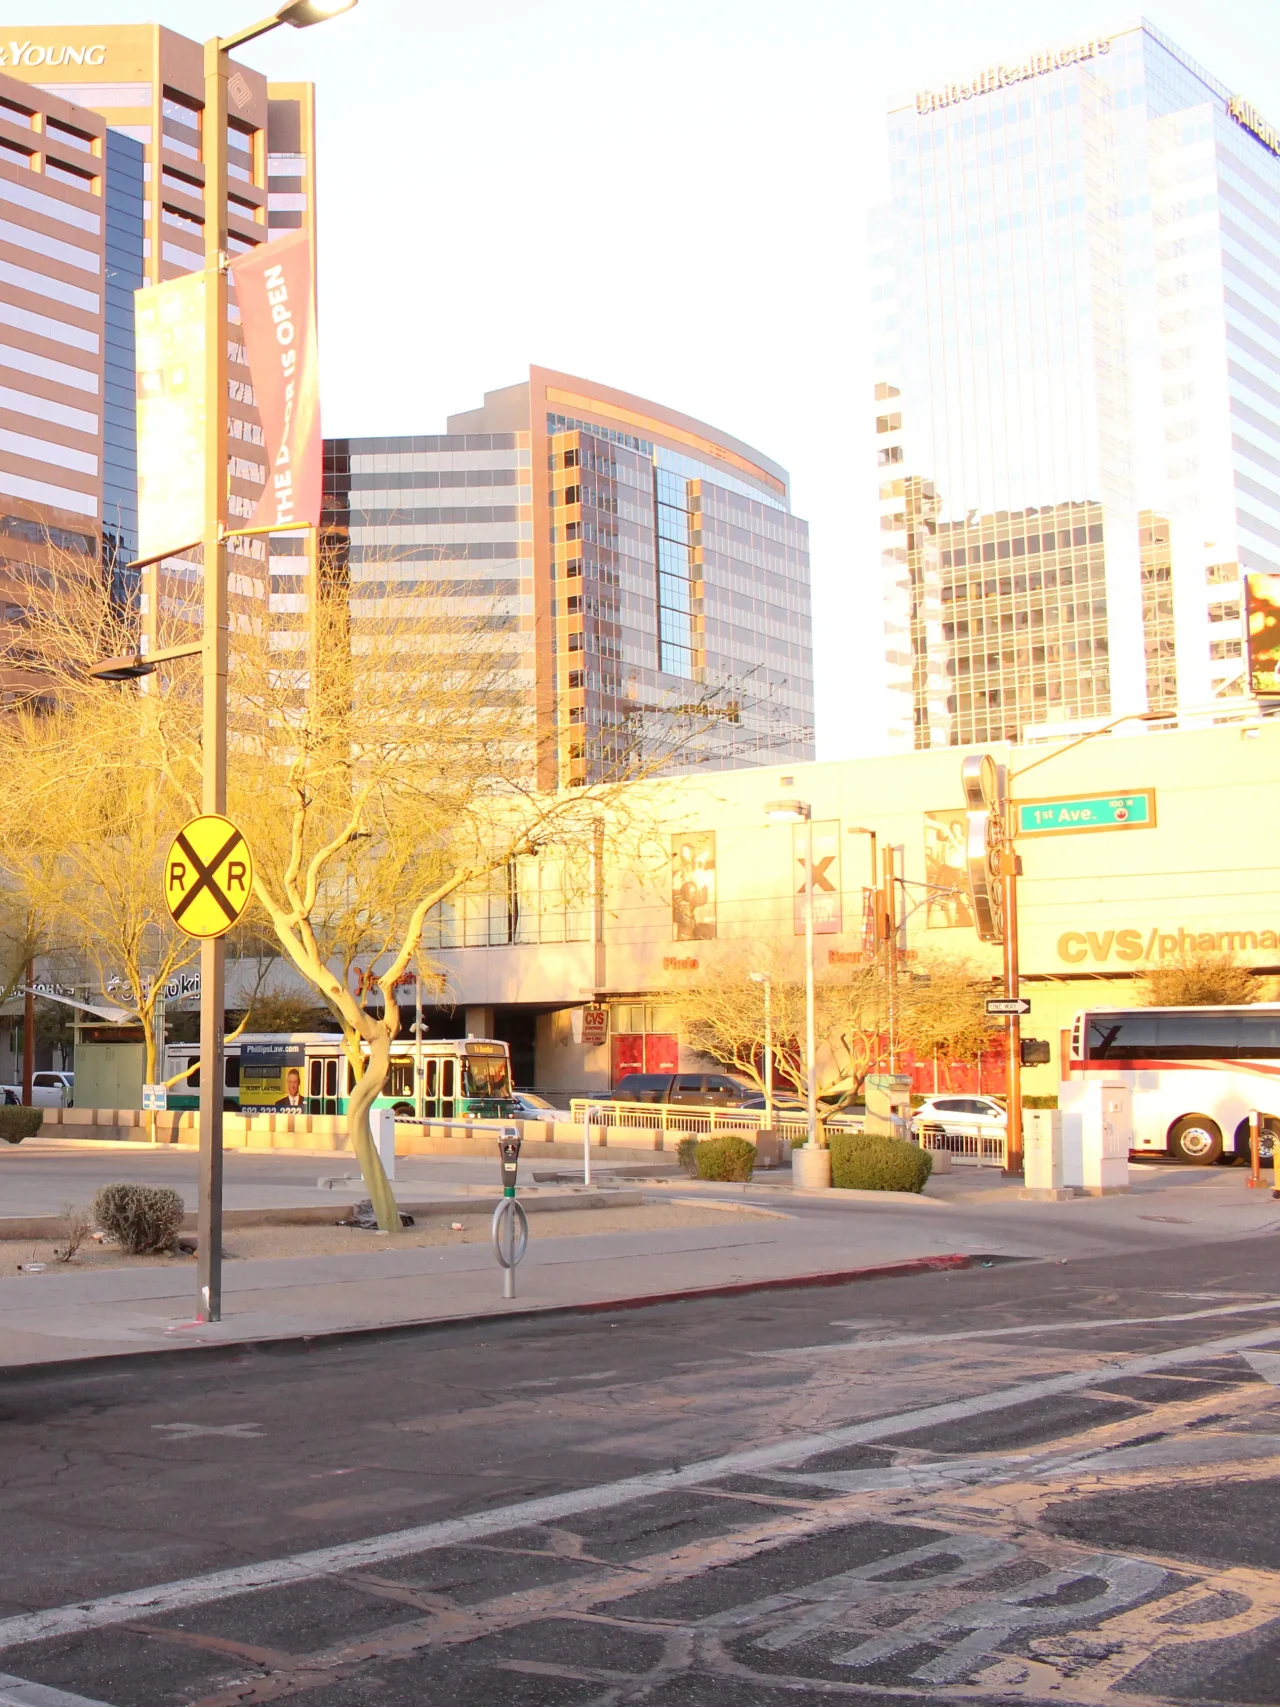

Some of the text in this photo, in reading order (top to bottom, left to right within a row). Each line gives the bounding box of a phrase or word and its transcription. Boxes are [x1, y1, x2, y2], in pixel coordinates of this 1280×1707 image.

[8, 41, 106, 67] YOUNG
[264, 264, 295, 345] OPEN
[281, 349, 296, 377] IS
[274, 470, 295, 526] THE
[1034, 808, 1097, 824] 1st Ave.
[1057, 927, 1280, 963] CVS/pharma
[585, 1012, 604, 1024] CVS
[247, 1045, 299, 1054] PhillipsLaw.com
